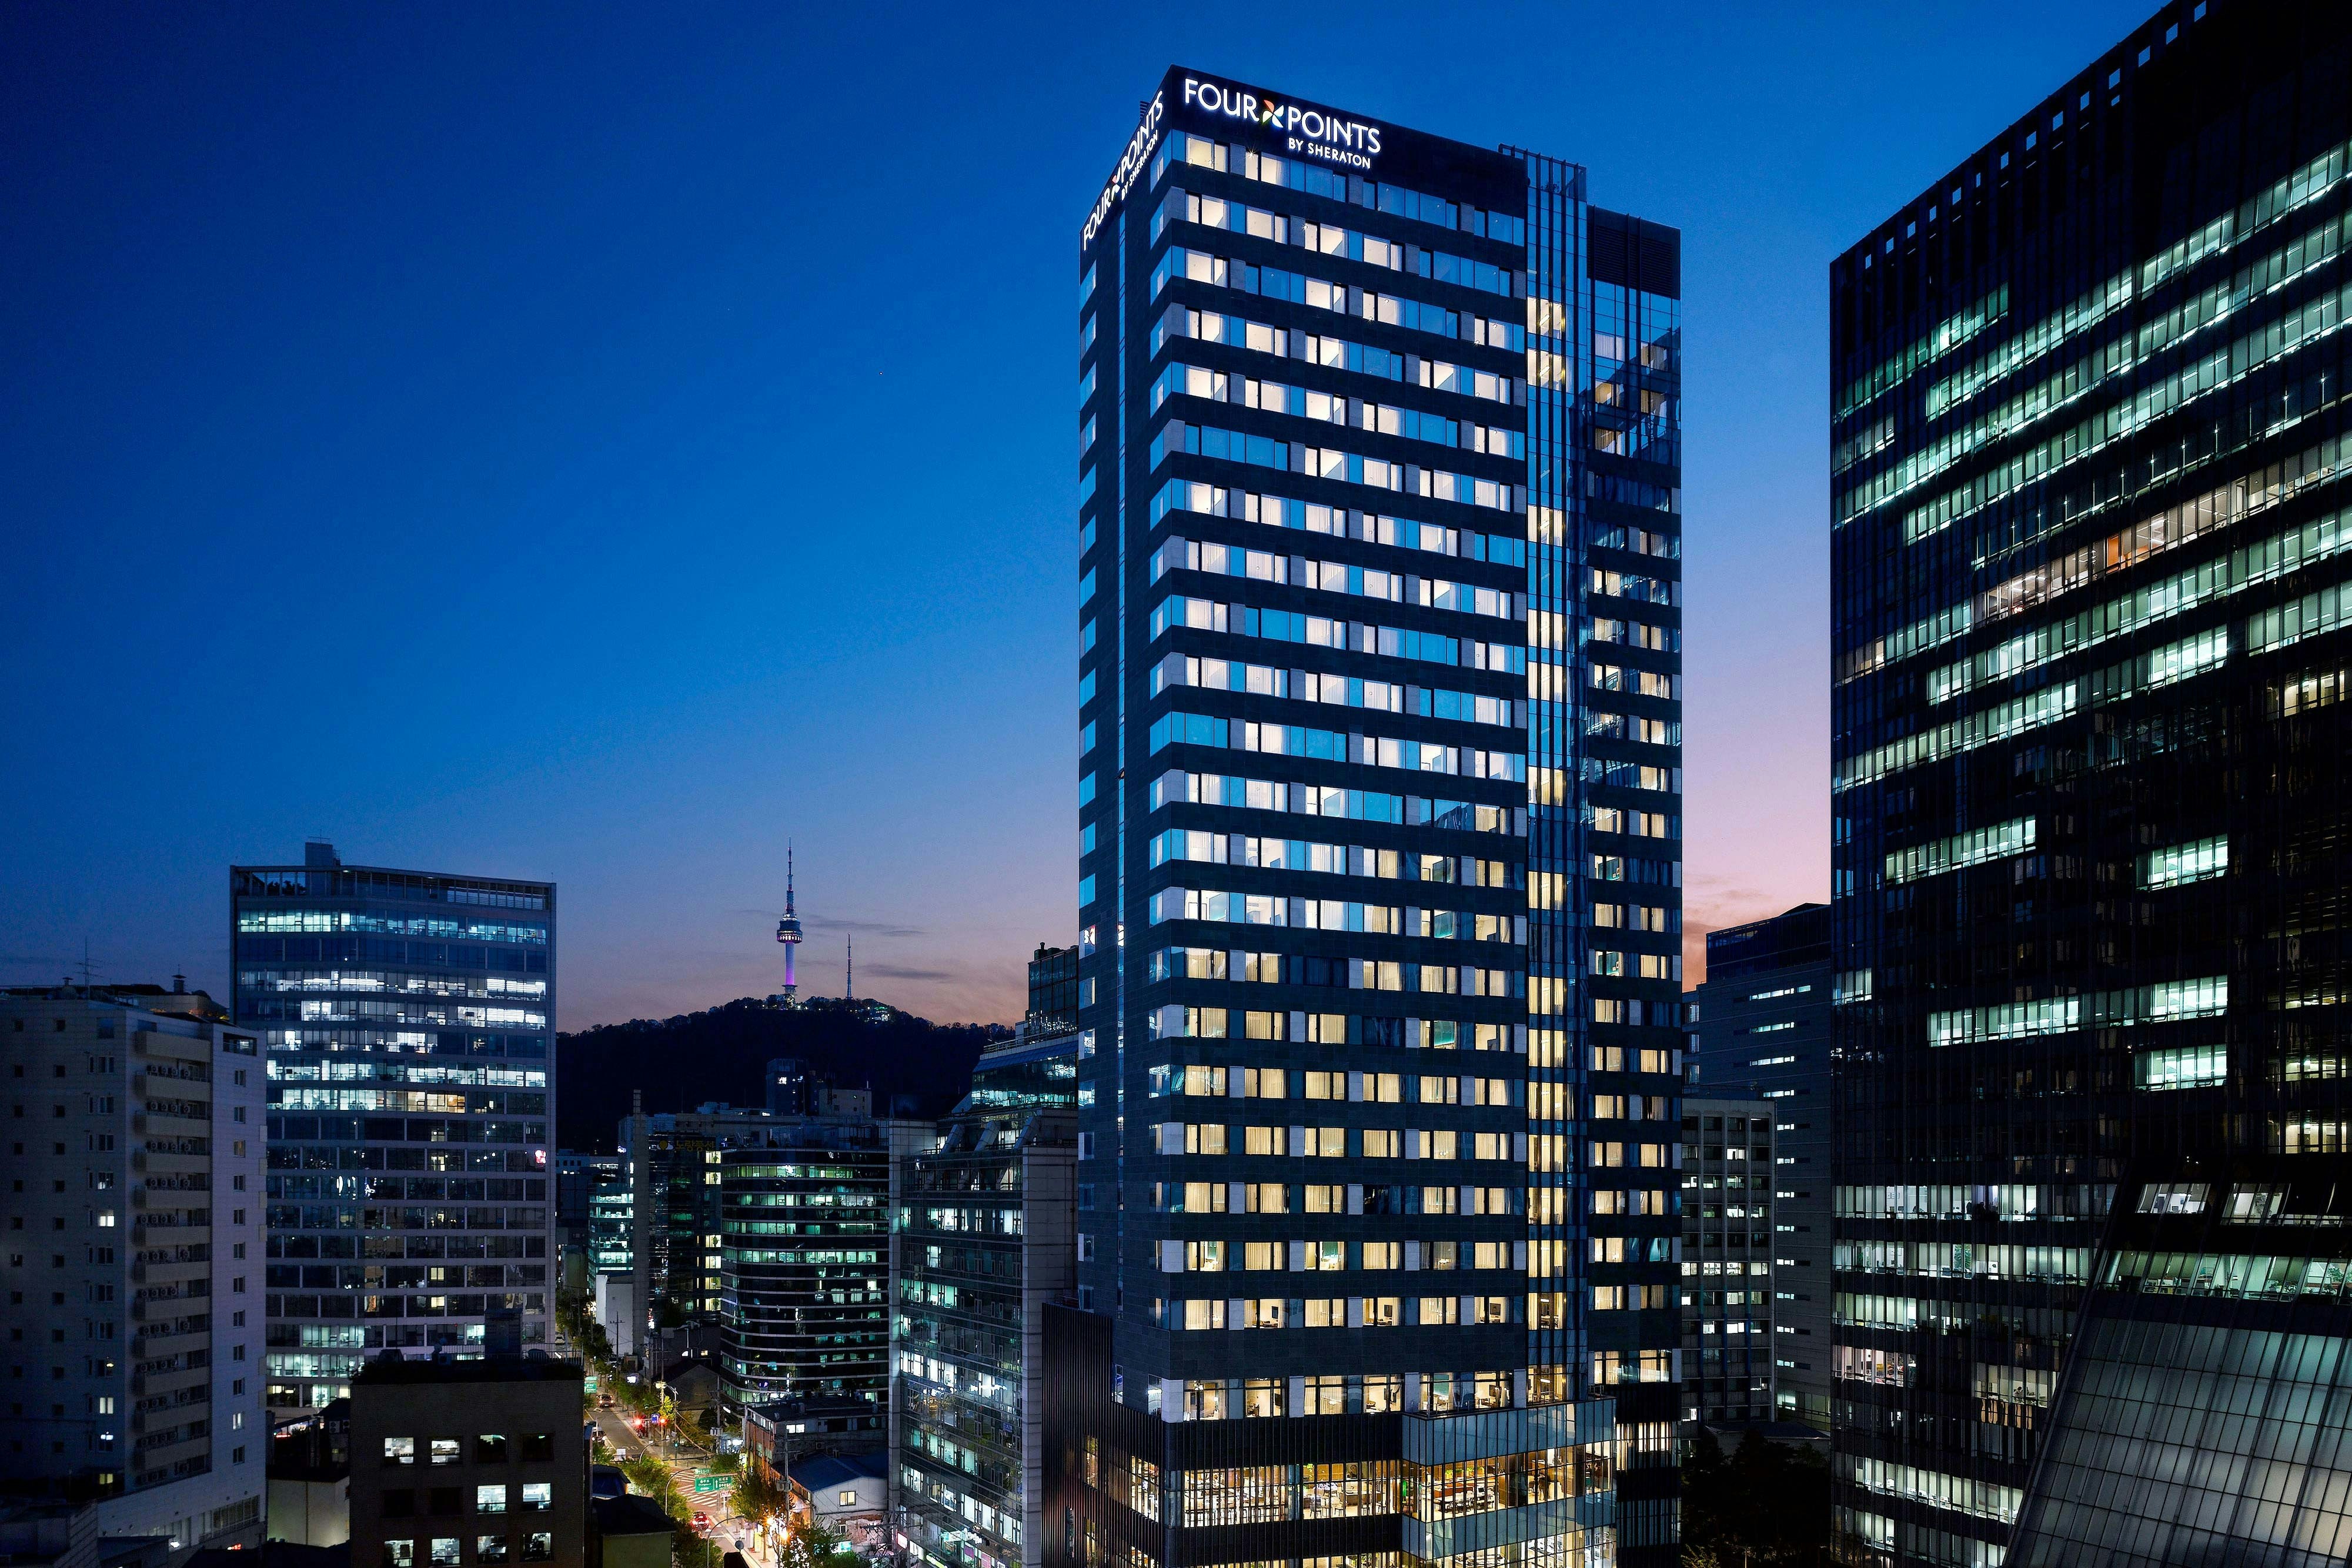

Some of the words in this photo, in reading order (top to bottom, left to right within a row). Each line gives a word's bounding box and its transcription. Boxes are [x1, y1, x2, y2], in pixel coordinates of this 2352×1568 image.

[1185, 78, 1259, 122] FOUR
[1288, 106, 1381, 153] POINTS
[1083, 187, 1111, 251] FOUR
[1121, 90, 1162, 183] POINTS
[1121, 180, 1129, 201] BY
[1129, 129, 1158, 187] SHERATON
[1288, 137, 1304, 151] BY
[1308, 143, 1371, 169] SHERATON
[676, 1141, 714, 1151] 노랑풍선
